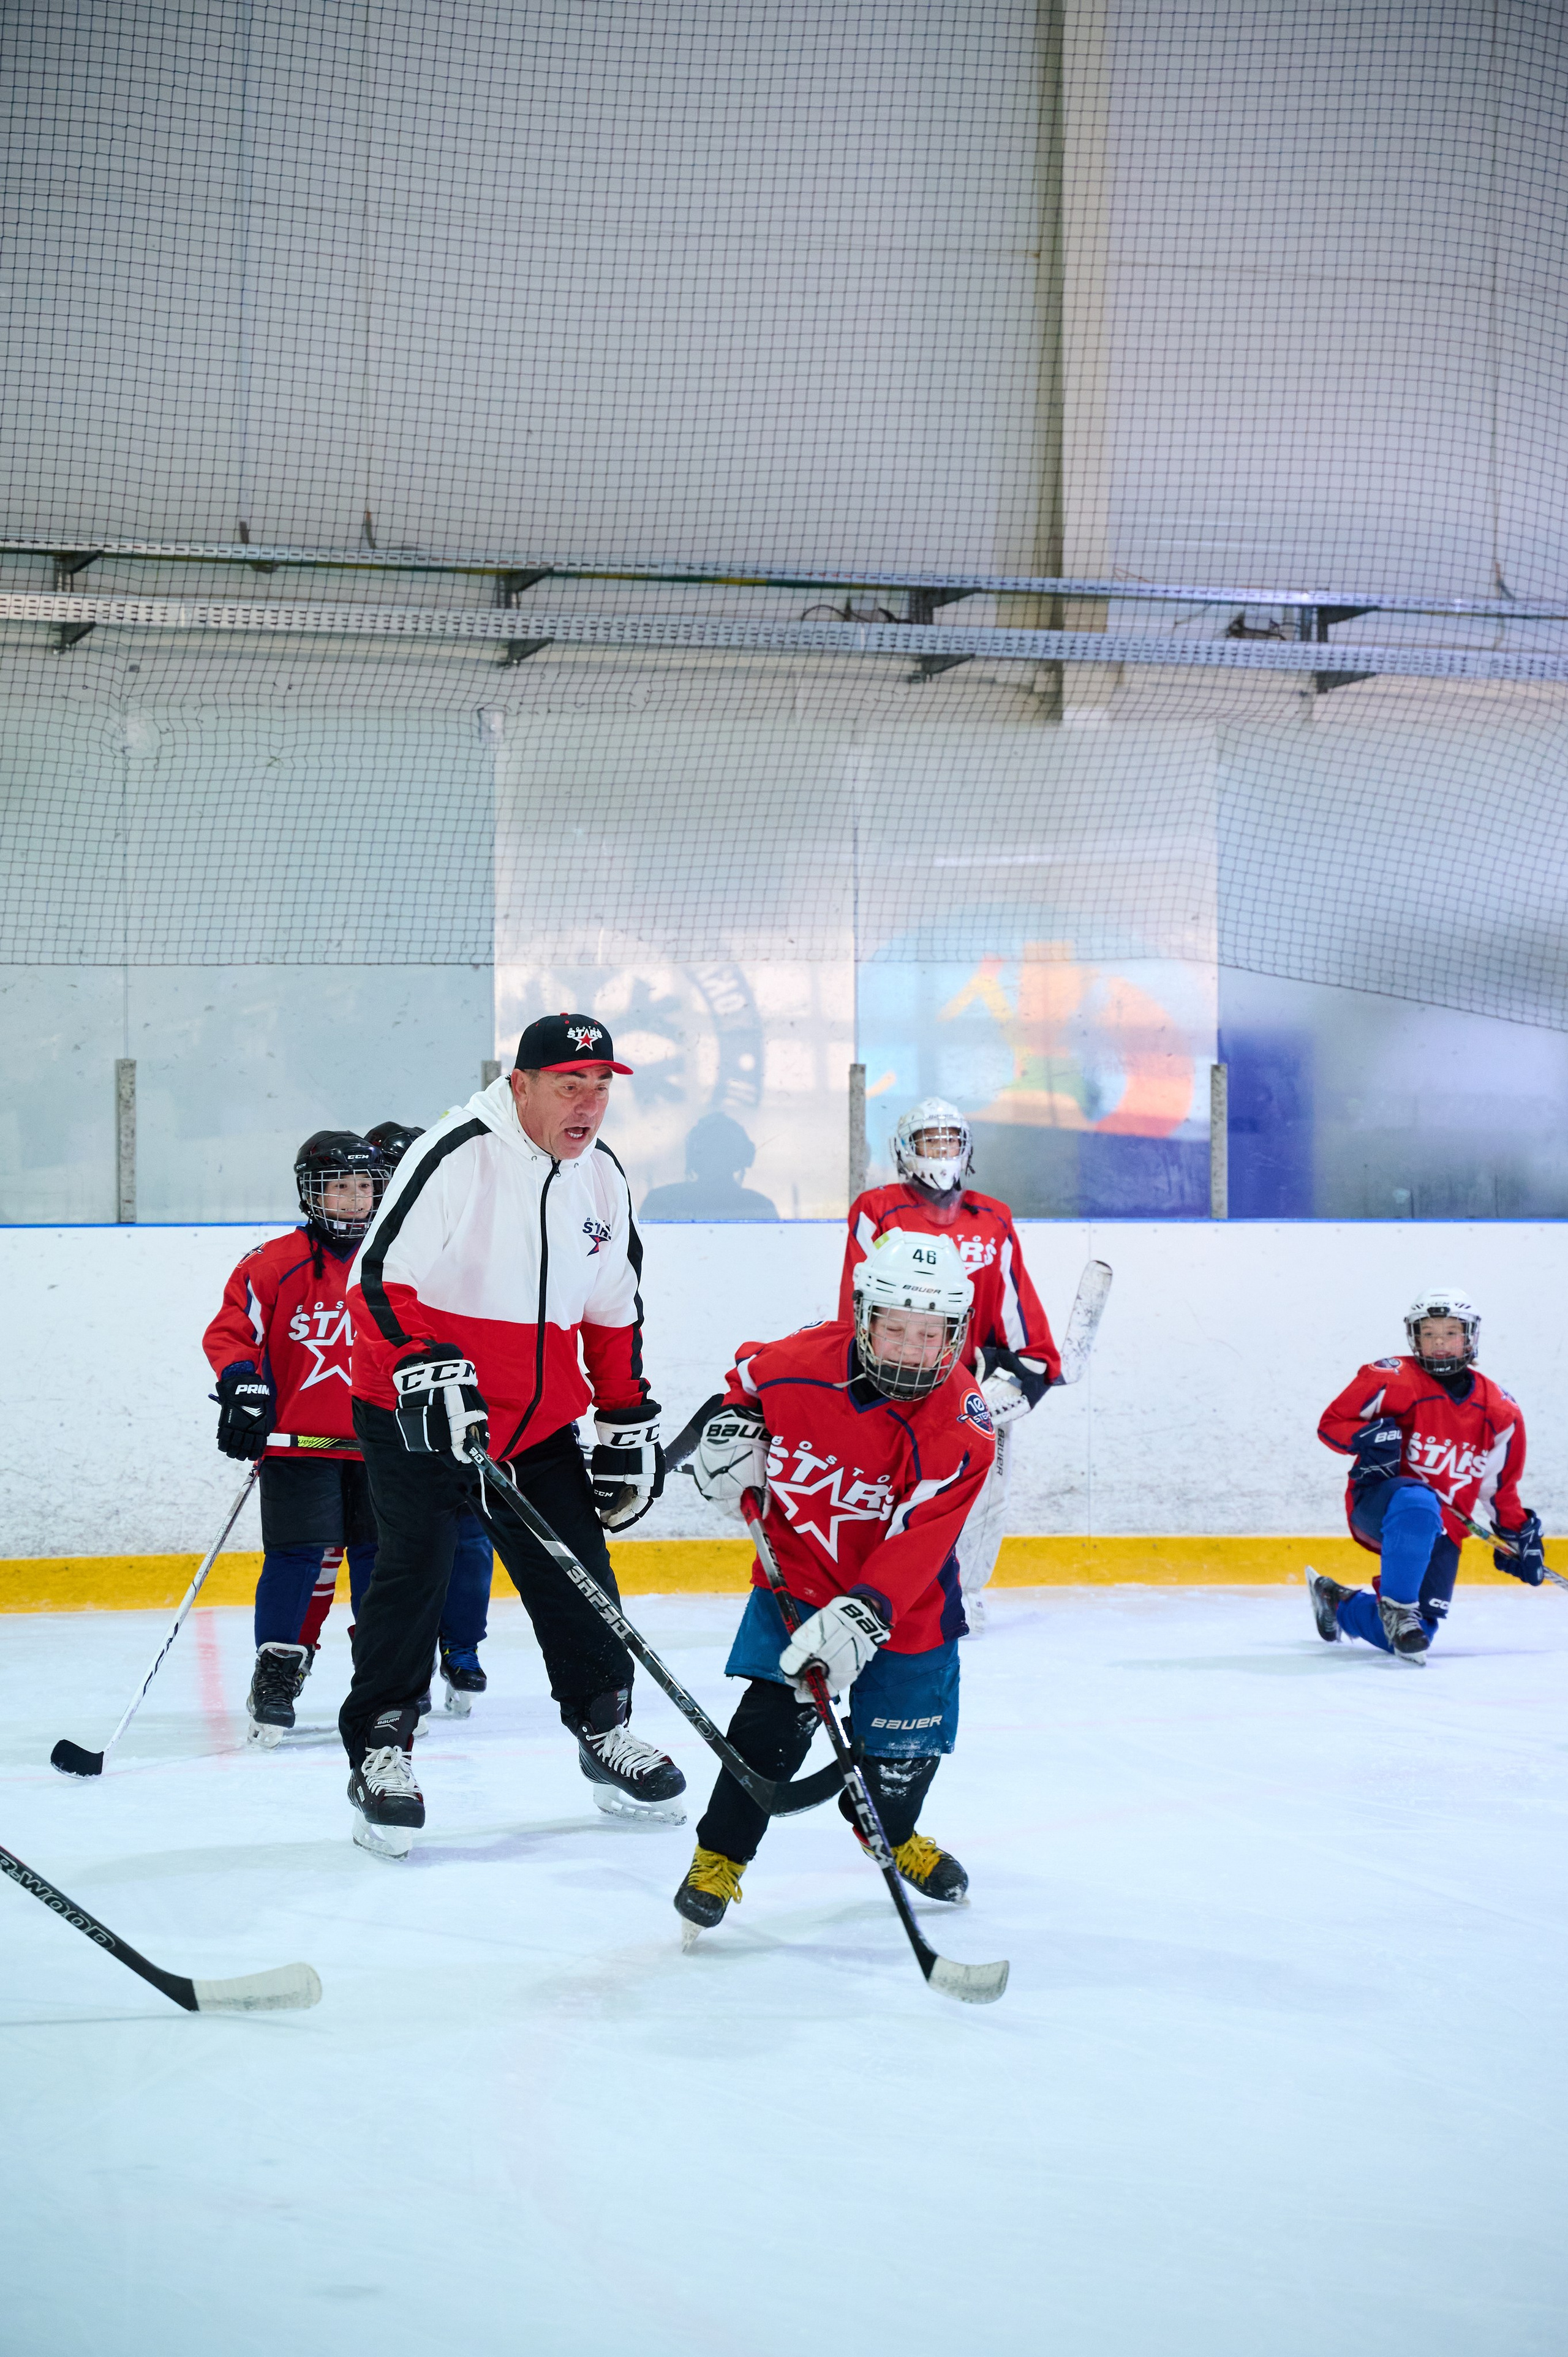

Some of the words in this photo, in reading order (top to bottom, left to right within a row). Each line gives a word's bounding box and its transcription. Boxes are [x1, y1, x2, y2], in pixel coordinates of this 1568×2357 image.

[567, 1028, 603, 1039] STARS
[913, 1249, 936, 1265] 46
[902, 1284, 941, 1294] BAUER
[296, 1300, 344, 1313] BOS
[288, 1308, 357, 1341] STA
[401, 1362, 476, 1392] CCM
[235, 1384, 270, 1395] PRIM
[968, 1397, 985, 1413] 10
[610, 1423, 660, 1446] CC
[706, 1424, 772, 1442] BAUE
[1374, 1430, 1402, 1443] BAU
[997, 1428, 1005, 1476] BAUER
[771, 1435, 892, 1488] BOSTO
[1428, 1597, 1450, 1611] CC
[840, 1603, 888, 1646] BAU
[377, 1716, 400, 1725] BAUER
[870, 1715, 943, 1730] BAUER
[844, 1771, 894, 1869] CCM
[0, 1851, 116, 1950] R-WOOD
